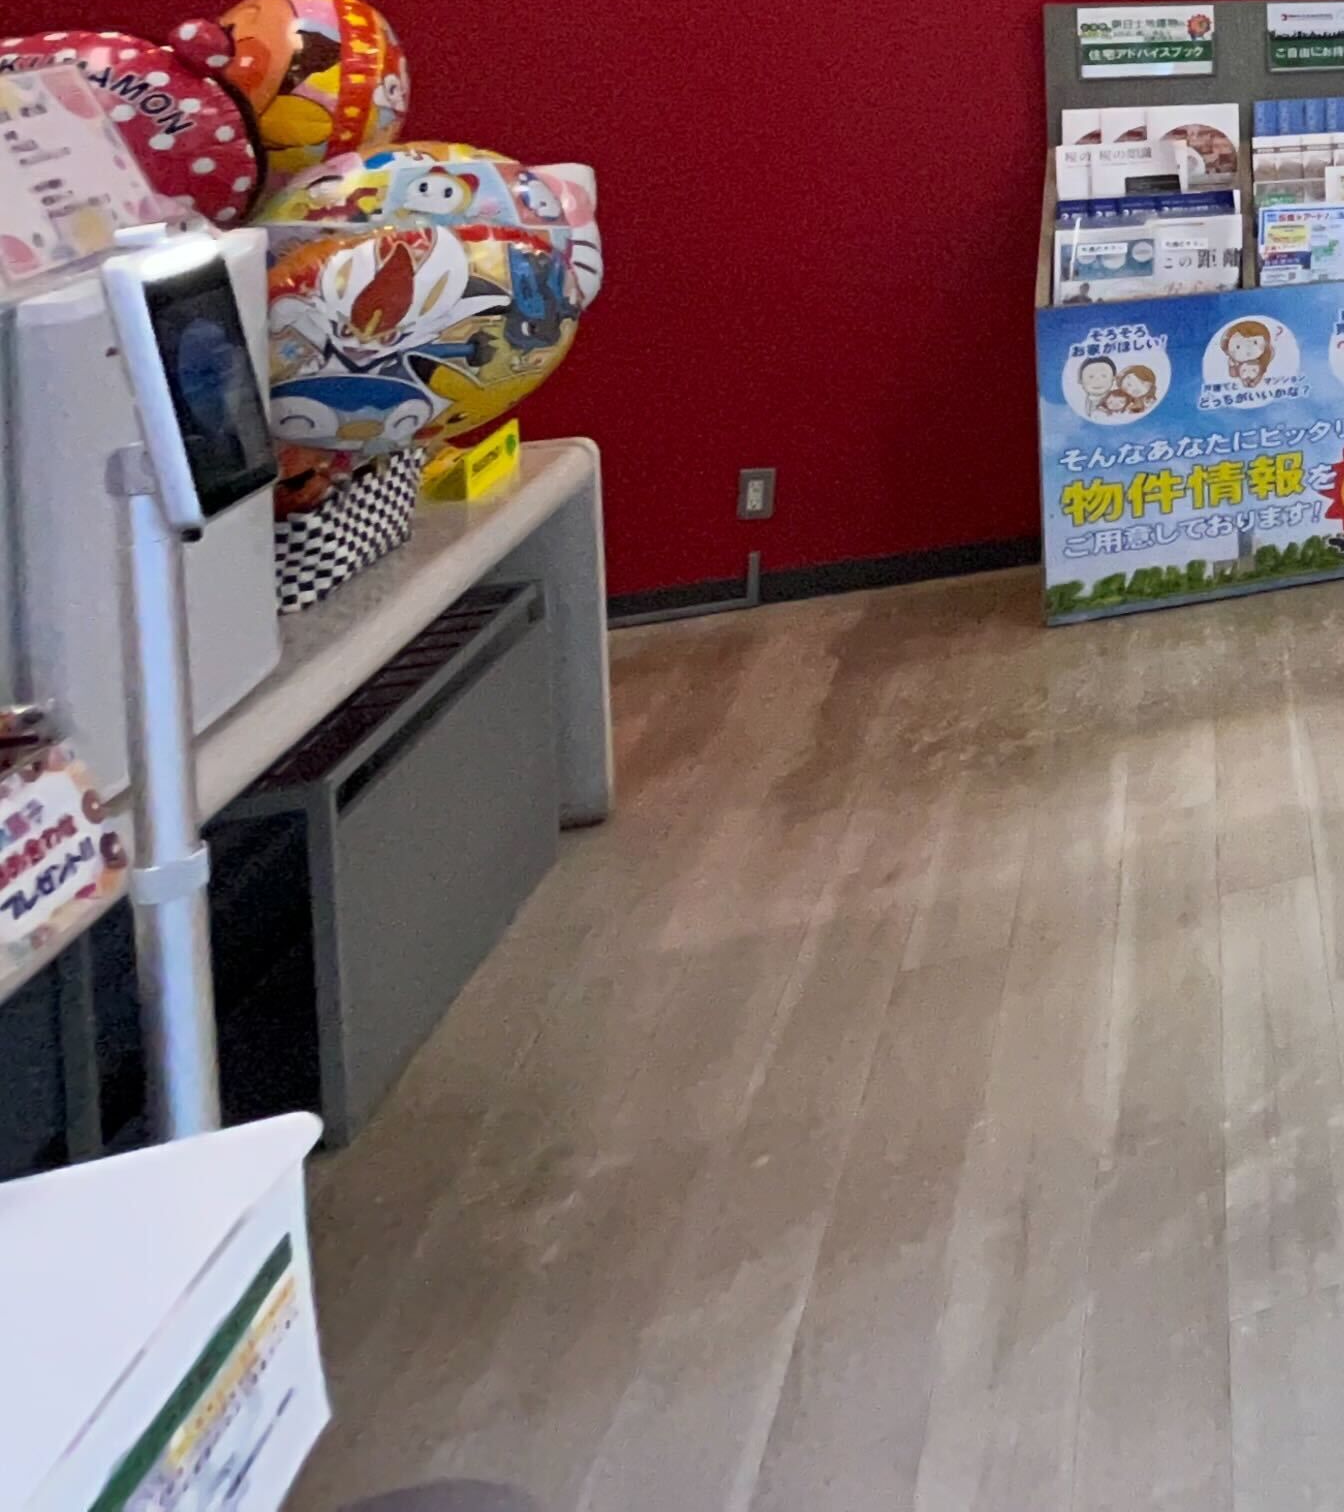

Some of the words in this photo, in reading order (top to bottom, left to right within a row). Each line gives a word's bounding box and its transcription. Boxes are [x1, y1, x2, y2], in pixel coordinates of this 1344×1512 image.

[1090, 327, 1147, 342] そろそろ
[1060, 450, 1335, 528] 物件情報を
